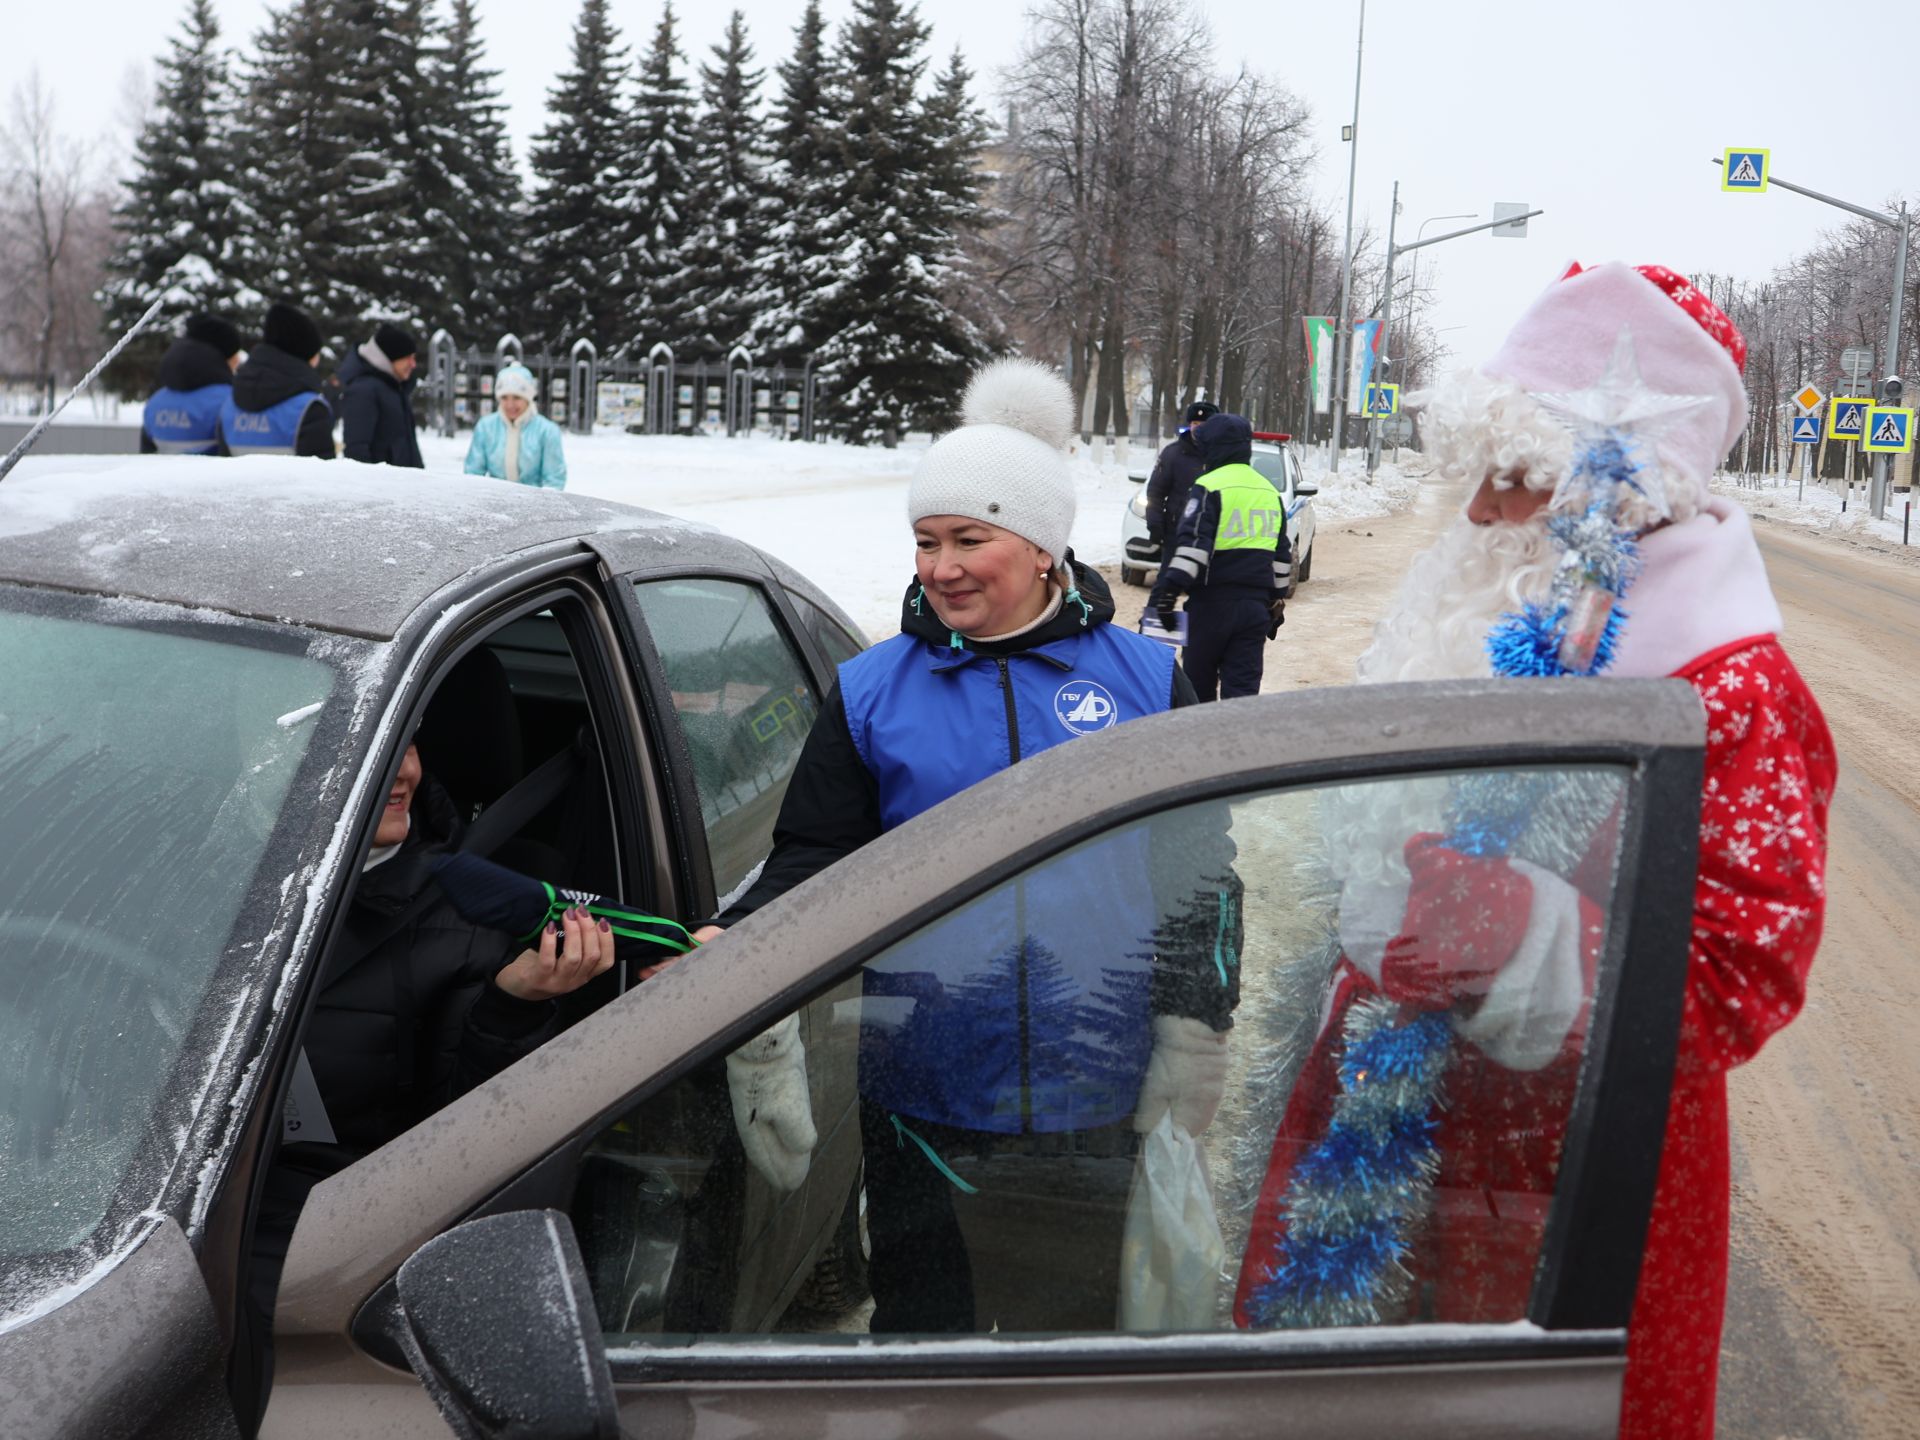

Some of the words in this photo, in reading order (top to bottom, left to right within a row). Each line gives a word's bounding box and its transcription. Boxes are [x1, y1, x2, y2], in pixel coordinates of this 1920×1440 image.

[156, 411, 191, 428] ЮИД
[234, 414, 270, 432] ЮИД
[1222, 508, 1280, 539] ДПС
[1062, 693, 1081, 702] ГБУ
